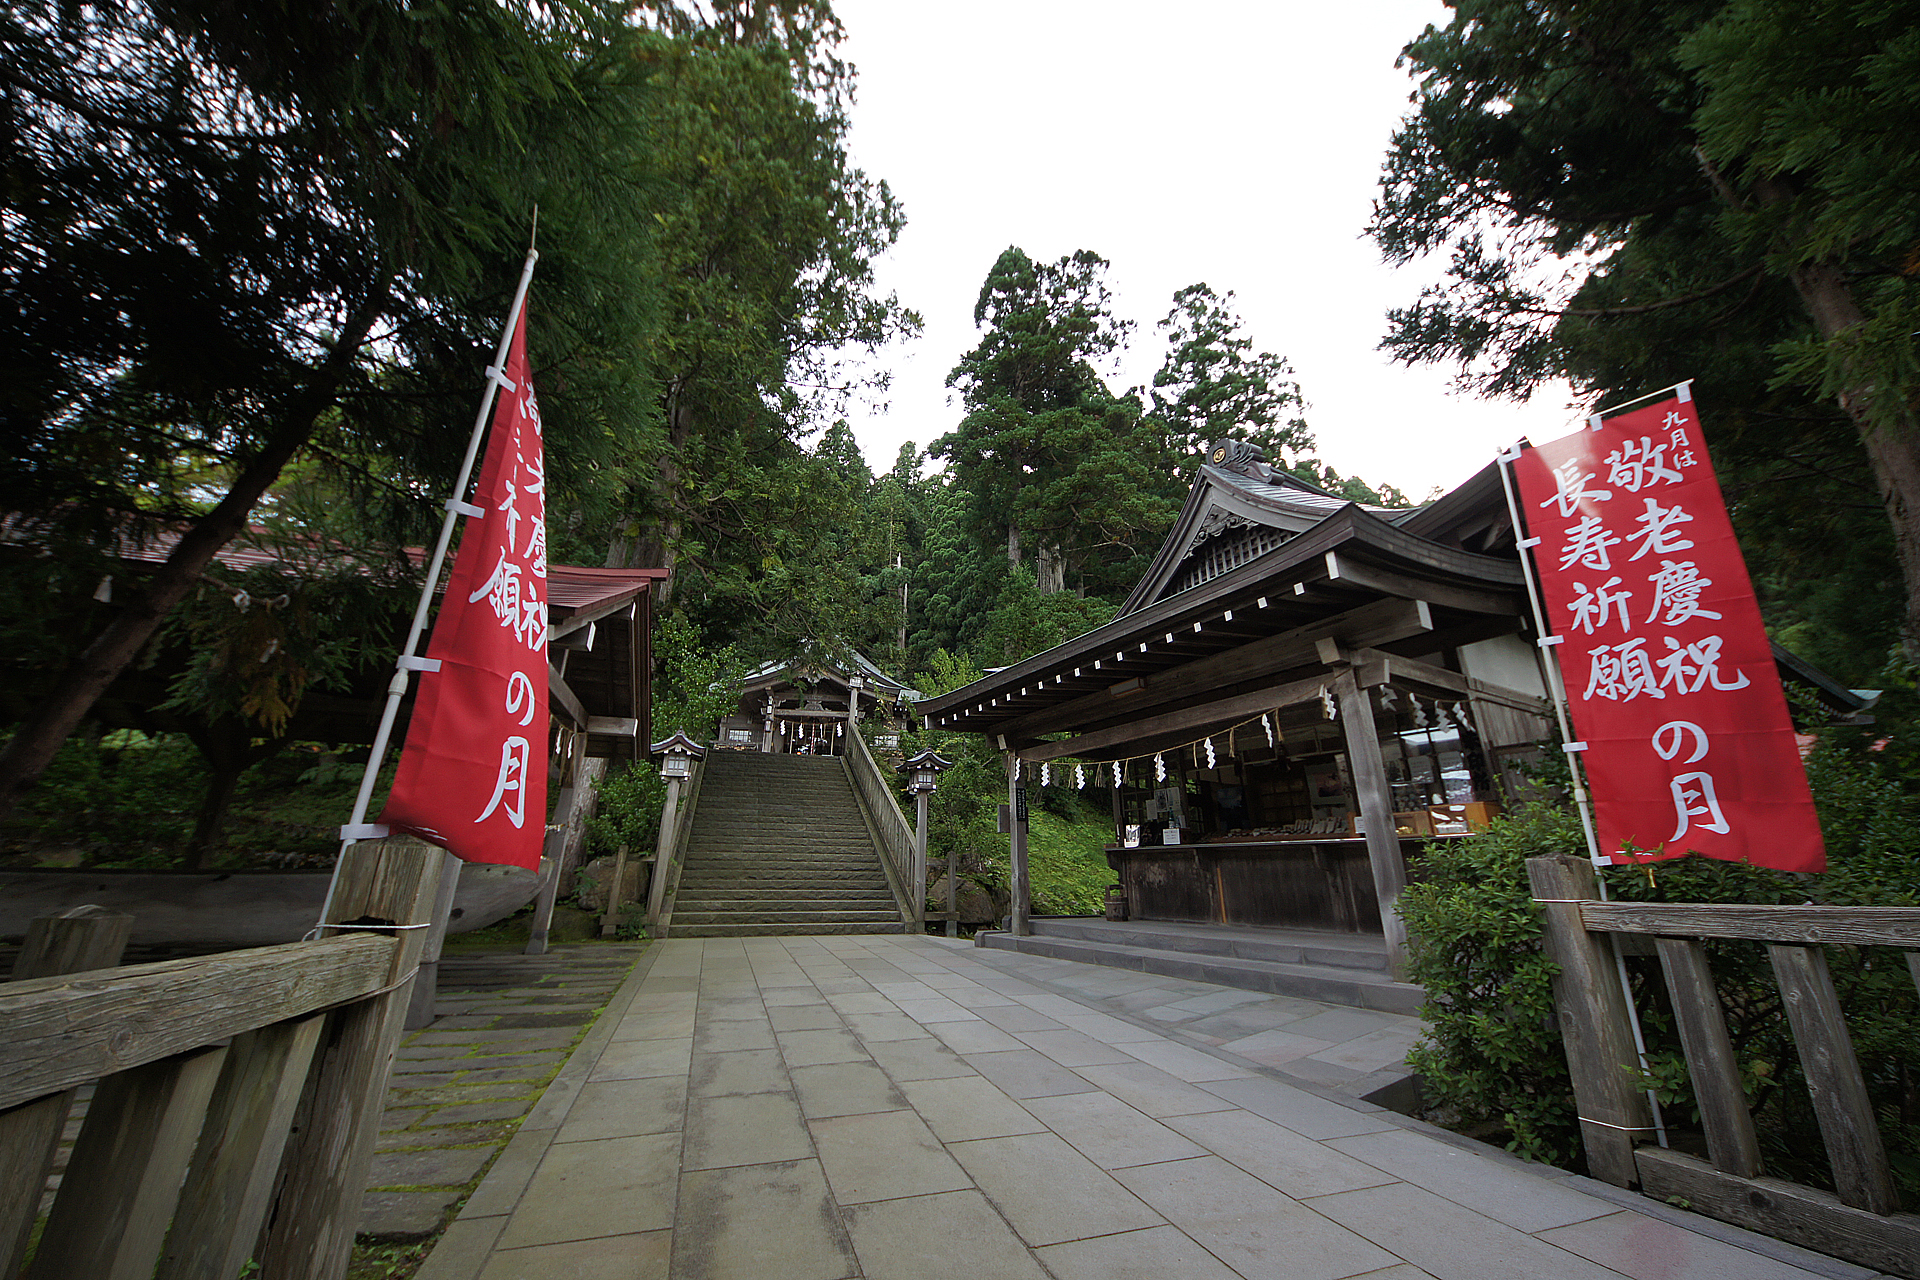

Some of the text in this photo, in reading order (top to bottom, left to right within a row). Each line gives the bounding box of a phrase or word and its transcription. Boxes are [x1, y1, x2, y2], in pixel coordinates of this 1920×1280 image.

[1661, 411, 1698, 470] 九月は
[1540, 458, 1665, 703] 長寿祈願
[1604, 436, 1750, 842] 敬老慶祝の月
